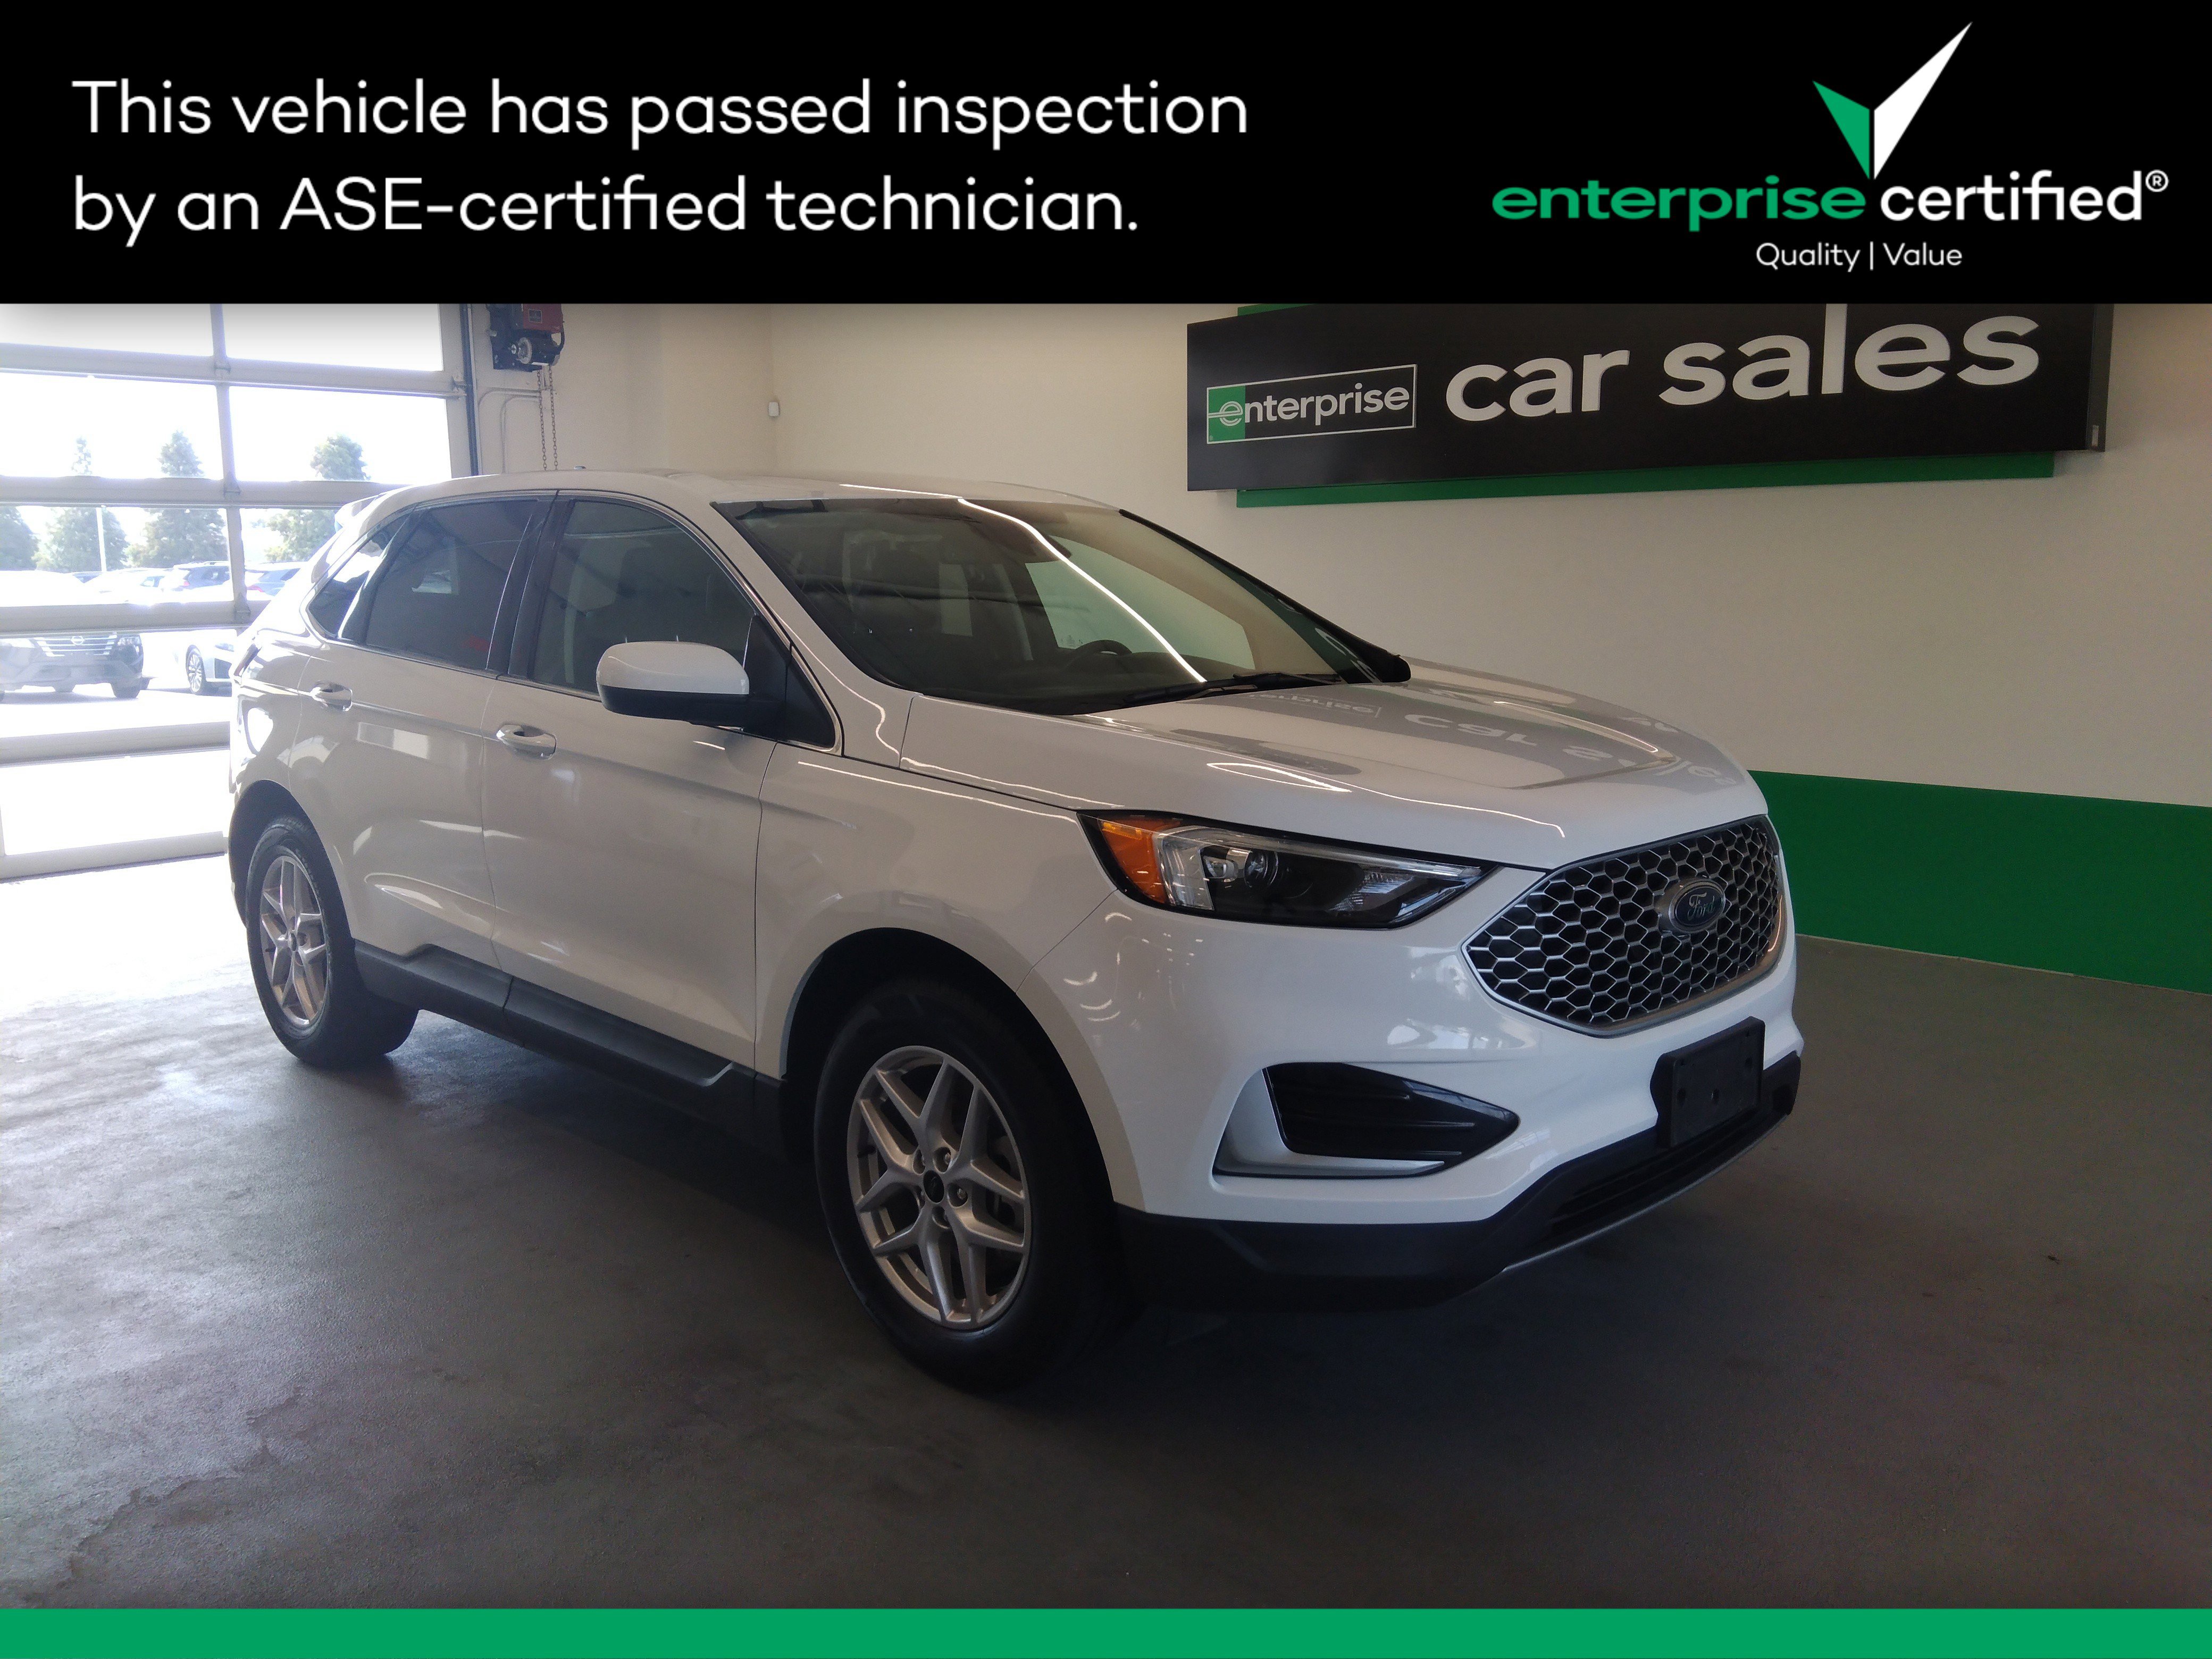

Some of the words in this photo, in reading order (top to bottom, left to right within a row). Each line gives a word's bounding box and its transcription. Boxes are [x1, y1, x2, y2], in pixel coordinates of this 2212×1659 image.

[1446, 349, 1630, 422] car
[1658, 304, 2040, 406] sales
[1218, 382, 1410, 426] enterprise
[1687, 892, 1716, 921] Ford
